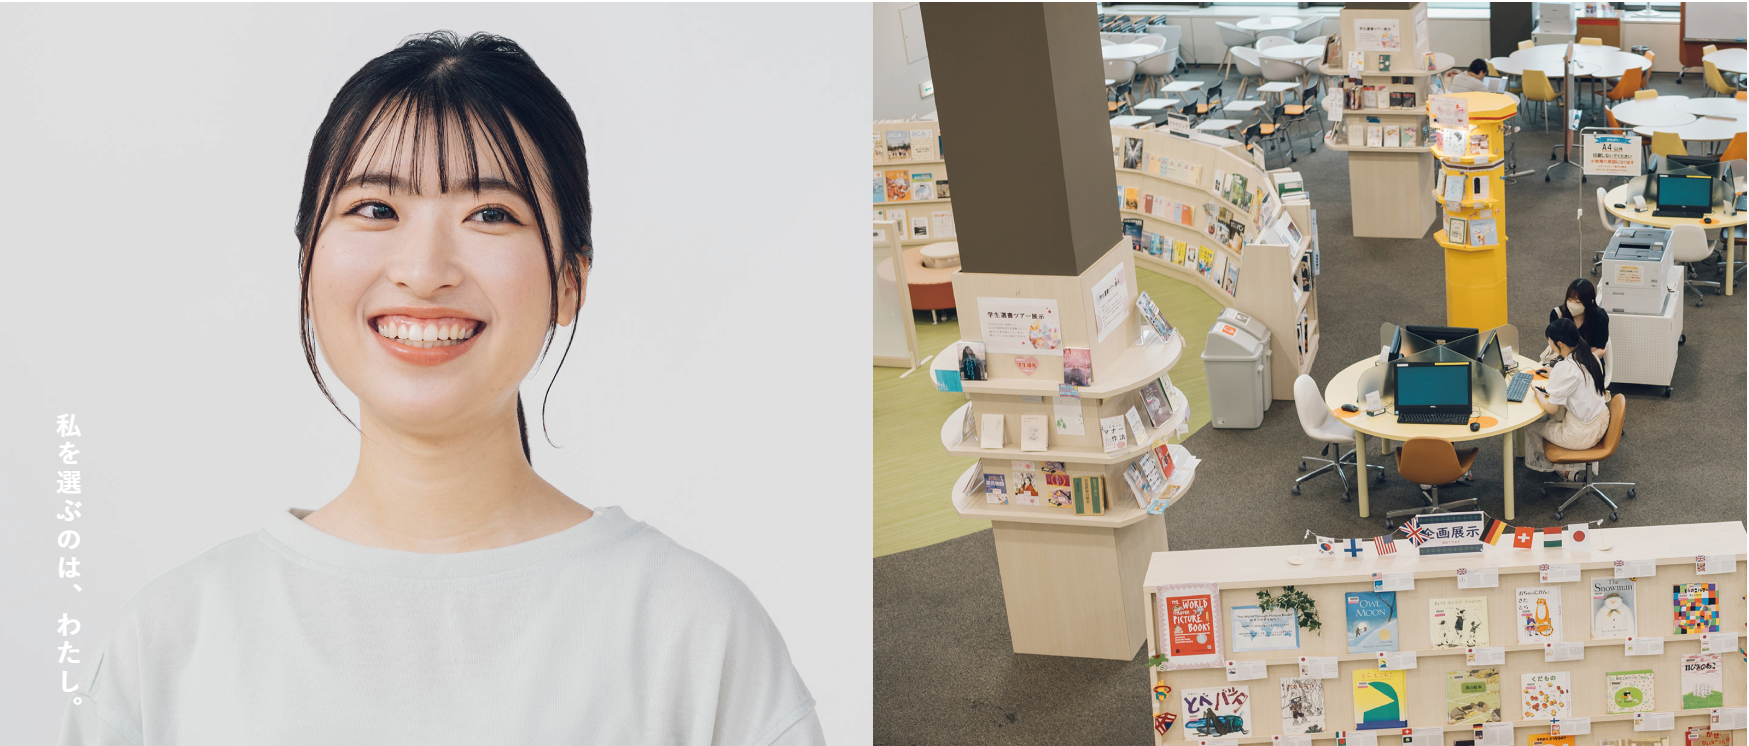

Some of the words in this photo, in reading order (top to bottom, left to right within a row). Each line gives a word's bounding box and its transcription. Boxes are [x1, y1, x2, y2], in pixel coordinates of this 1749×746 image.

[987, 311, 1045, 320] 学生選書ツアー展示
[1594, 582, 1633, 592] Snowman
[1182, 599, 1208, 609] WORLD
[1360, 600, 1381, 608] OWL
[1356, 609, 1386, 617] MOON
[1173, 614, 1203, 624] PICTURE
[1188, 623, 1211, 632] BOOKS
